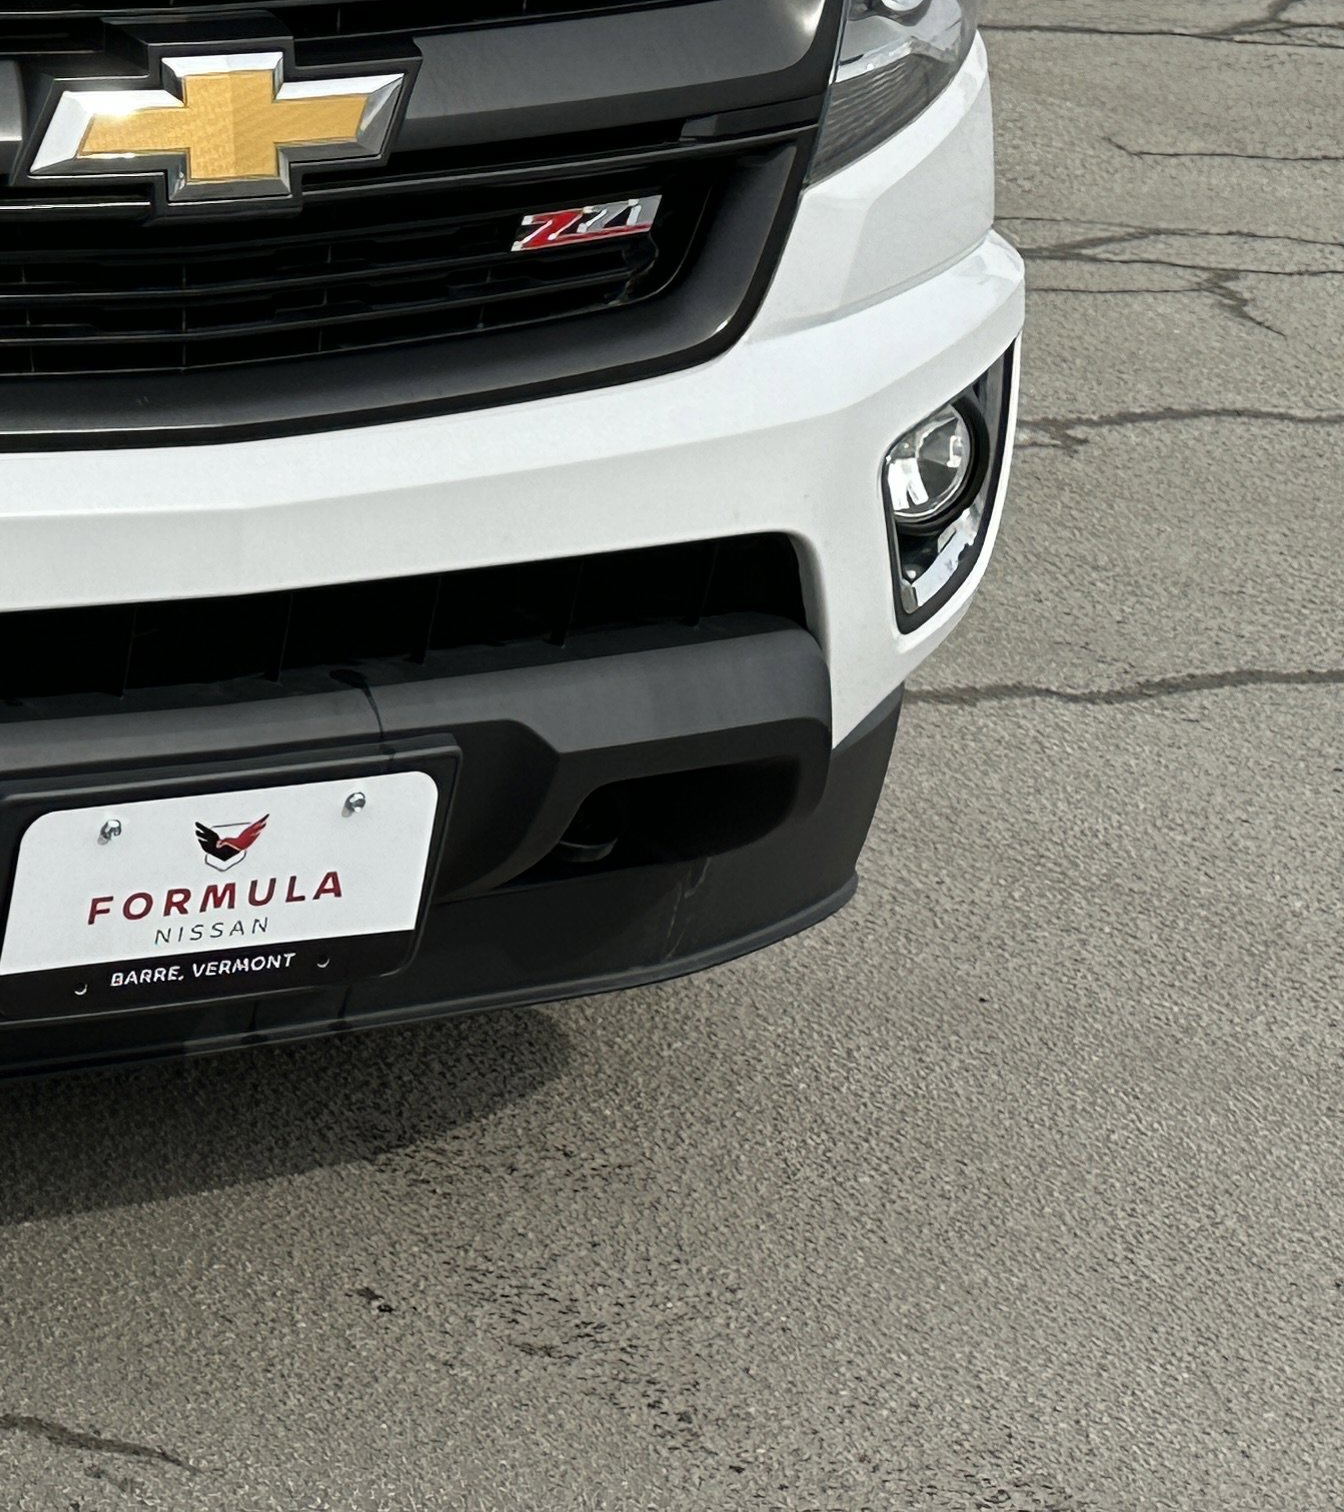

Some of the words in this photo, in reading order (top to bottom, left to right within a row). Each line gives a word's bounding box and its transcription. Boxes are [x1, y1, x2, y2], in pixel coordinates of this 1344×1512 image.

[510, 194, 662, 252] Z71
[87, 871, 343, 926] FORMULA
[154, 917, 269, 945] NISSAN
[110, 965, 185, 987] BARRE,
[192, 952, 297, 978] VERMONT
